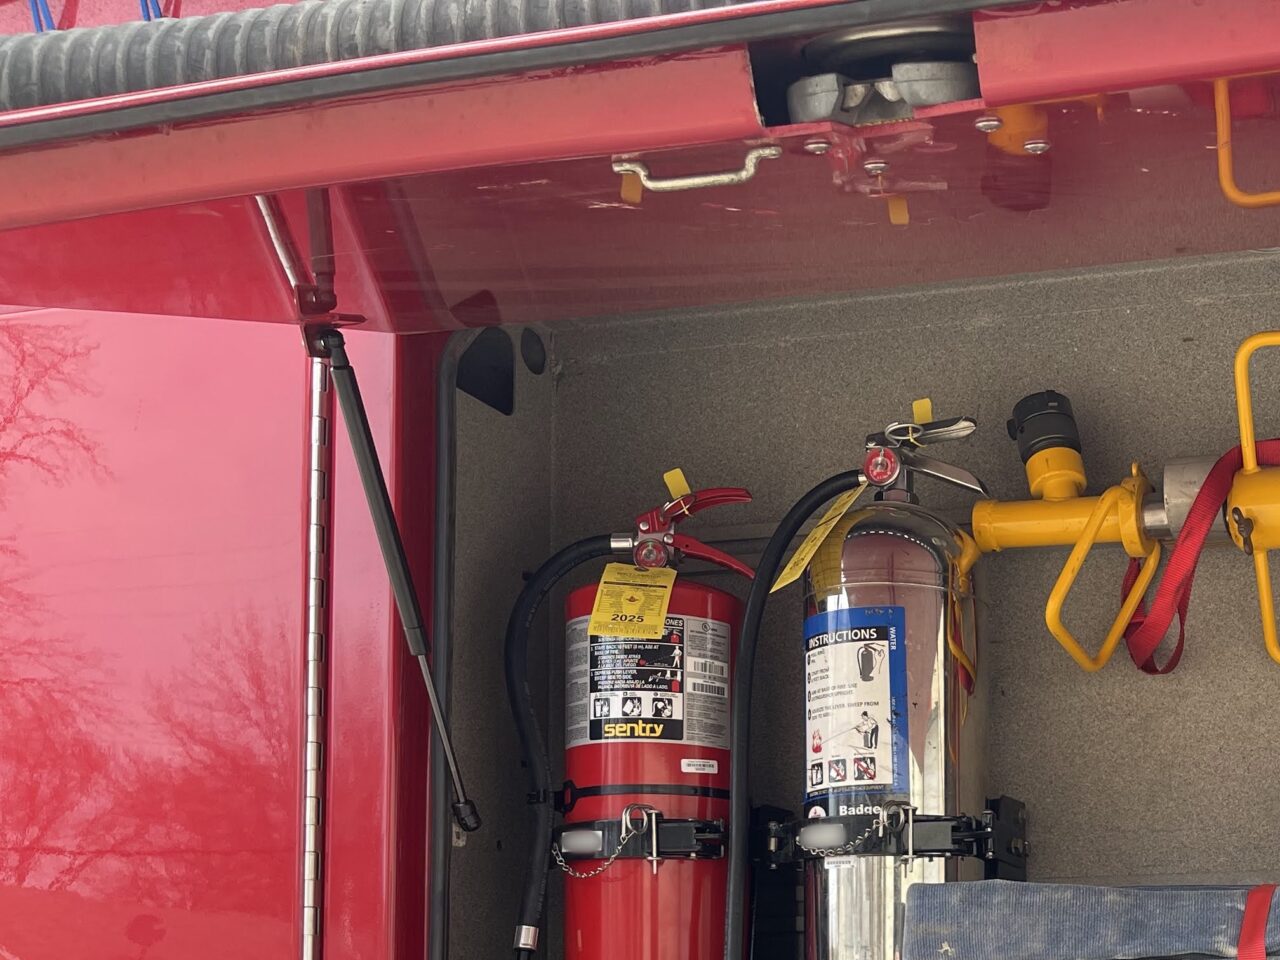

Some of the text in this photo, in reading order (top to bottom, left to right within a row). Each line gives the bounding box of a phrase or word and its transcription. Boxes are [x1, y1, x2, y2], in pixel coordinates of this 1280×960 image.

[610, 613, 645, 623] 2025
[808, 628, 877, 649] INSTRUCTIONS
[889, 626, 897, 650] WATER
[604, 719, 664, 737] sentry
[839, 803, 881, 816] Badge
